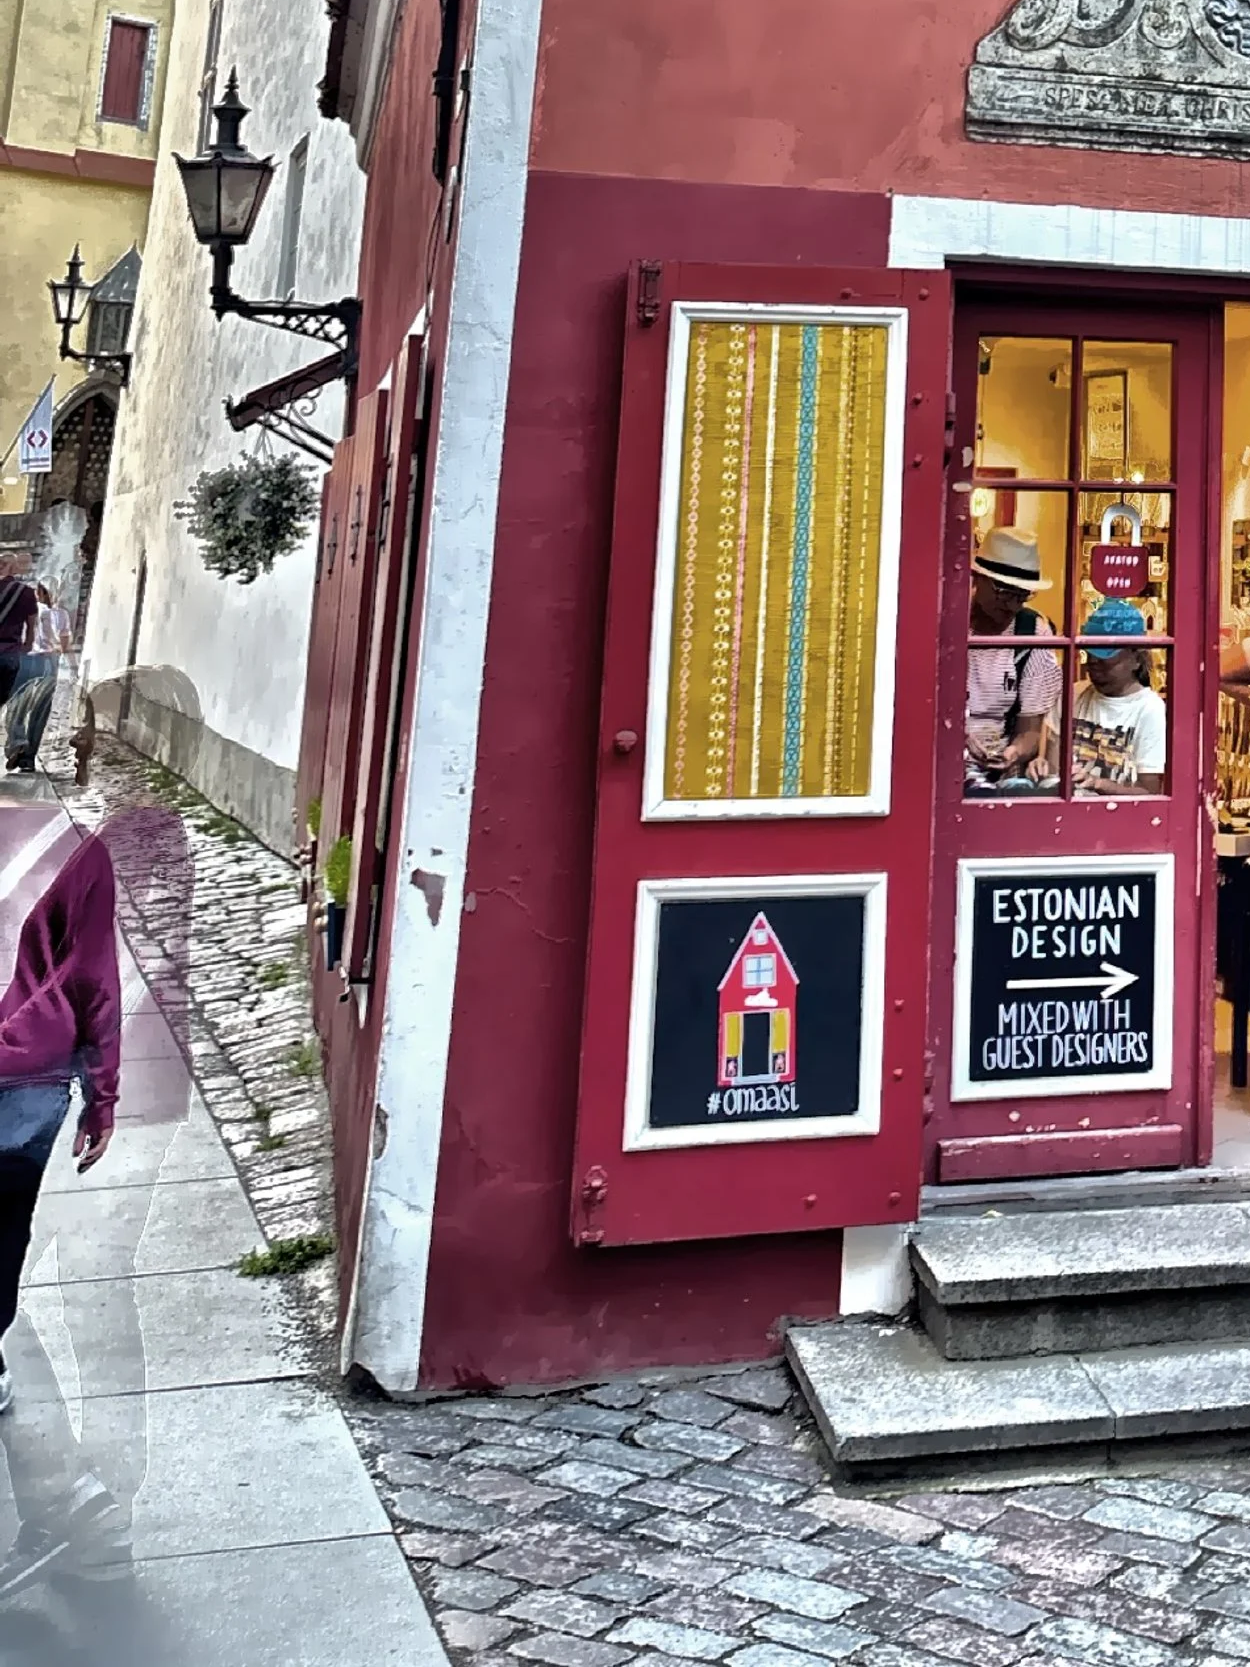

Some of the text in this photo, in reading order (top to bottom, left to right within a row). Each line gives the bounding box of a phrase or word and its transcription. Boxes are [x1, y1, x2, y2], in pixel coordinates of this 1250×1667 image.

[1106, 576, 1132, 589] OPEN
[993, 885, 1139, 924] ESTONIAN
[1011, 924, 1121, 958] DESIGN
[998, 998, 1130, 1035] MIXED WITH
[982, 1031, 1148, 1071] GUEST DESIGNERS
[707, 1082, 800, 1116] #omaasi
